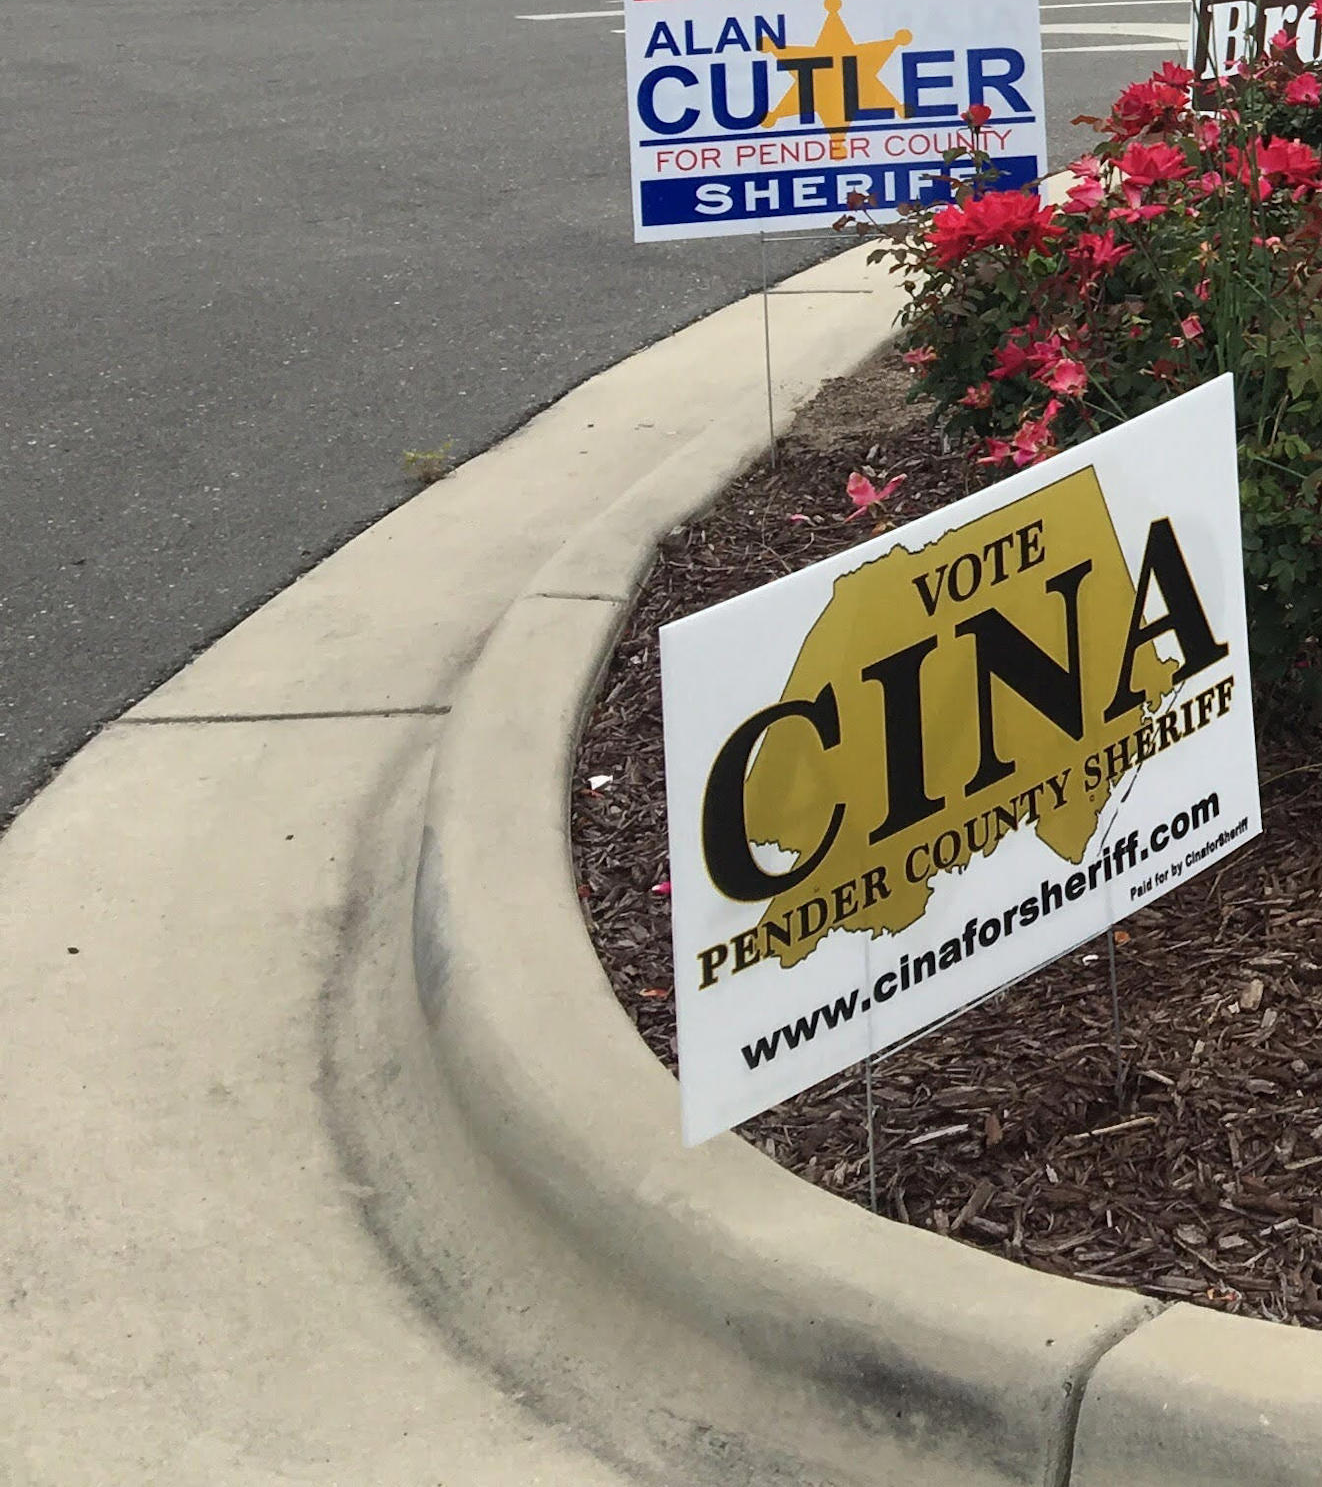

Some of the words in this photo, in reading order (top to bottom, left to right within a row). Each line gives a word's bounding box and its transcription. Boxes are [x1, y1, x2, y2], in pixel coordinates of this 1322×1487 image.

[644, 14, 786, 58] ALAN
[637, 47, 1032, 134] CUTLER
[656, 149, 721, 173] FOR
[736, 136, 871, 167] PENDER
[884, 129, 1013, 157] COUNTY
[913, 518, 1048, 616] VOTE
[701, 517, 1230, 902] CINA
[698, 869, 893, 990] PENDER
[905, 768, 1072, 887] COUNTY
[1084, 675, 1236, 793] SHERIFF
[1130, 878, 1152, 901] Paid
[1155, 869, 1169, 886] for
[1171, 861, 1183, 877] by
[741, 790, 1220, 1071] www.cinaforsheriff.com
